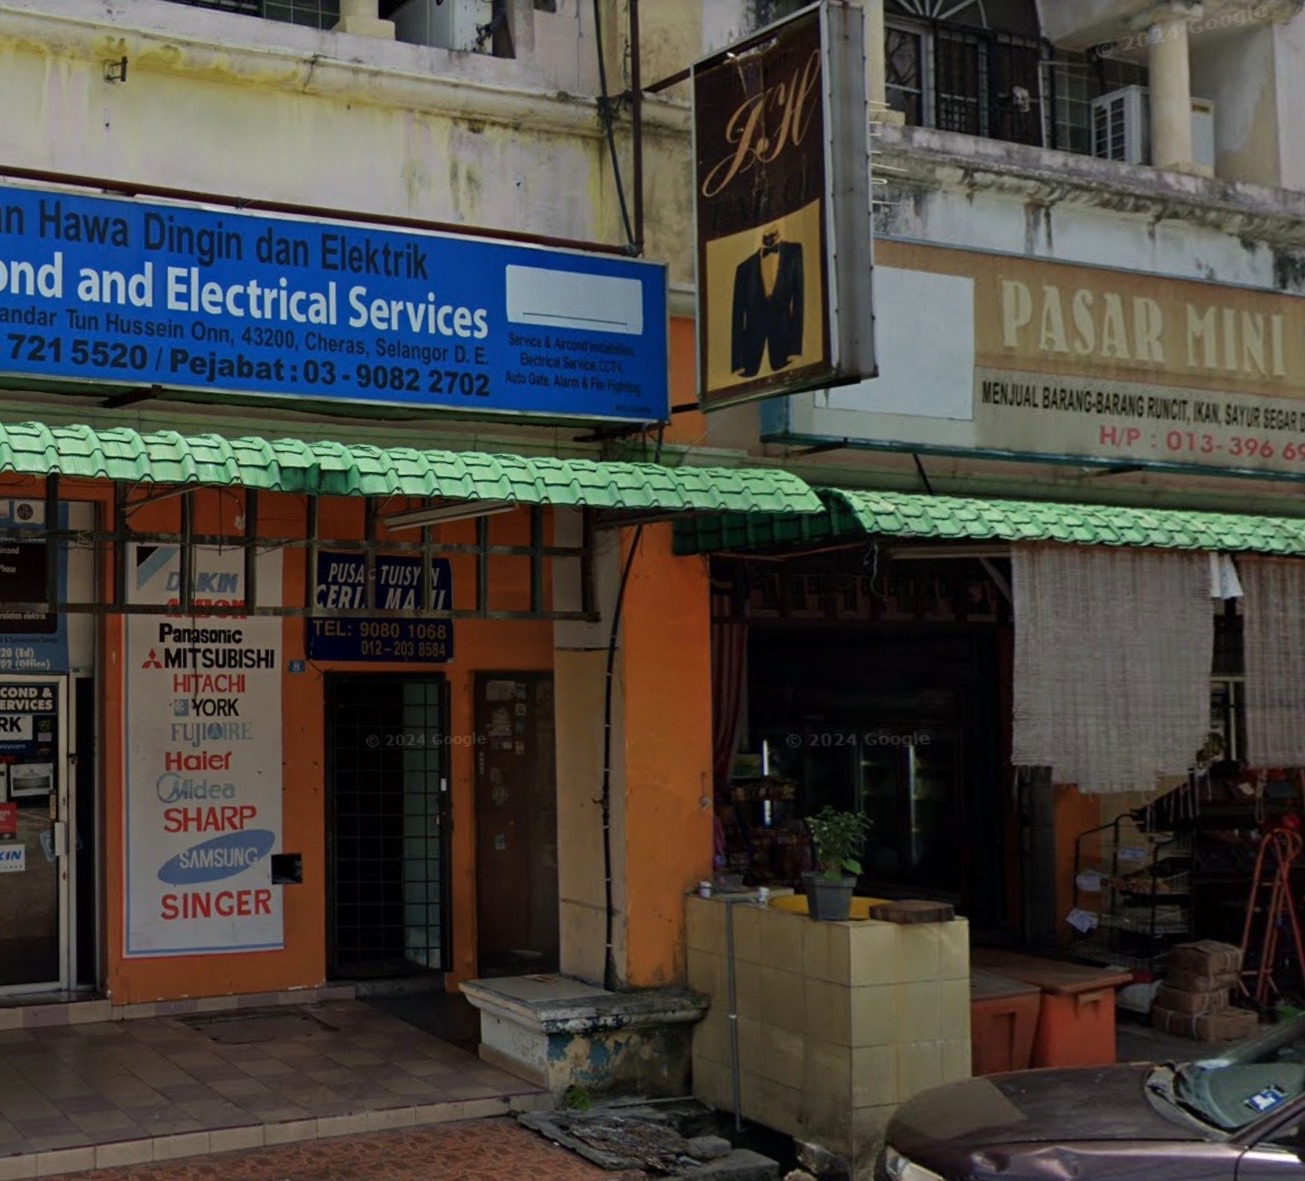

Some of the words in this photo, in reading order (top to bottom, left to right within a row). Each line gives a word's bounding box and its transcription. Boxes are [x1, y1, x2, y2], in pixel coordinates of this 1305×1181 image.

[39, 199, 129, 247] Hawa
[144, 212, 242, 267] Dingin
[256, 227, 309, 267] dan
[321, 233, 428, 280] Elektrik
[78, 262, 153, 308] and
[167, 266, 336, 325] Electrical
[349, 286, 488, 339] Services
[65, 309, 99, 331] Tun
[106, 313, 184, 339] Hussein
[191, 321, 235, 347] Onn,
[241, 326, 299, 351] 43200,
[305, 332, 369, 358] Cheras,
[376, 338, 448, 366] Selangor
[455, 345, 469, 364] D.
[475, 346, 490, 365] E.
[1001, 280, 1166, 364] PASAR
[1186, 302, 1289, 377] MINI
[508, 332, 542, 348] Service
[544, 336, 552, 348] &
[555, 337, 588, 351] Aircond
[7, 333, 61, 362] 721
[71, 340, 148, 370] 5520
[170, 347, 284, 382] Pejabat
[303, 360, 336, 385] 03
[356, 364, 420, 392] 9082
[428, 370, 491, 397] 2702
[520, 352, 561, 368] Electrical
[505, 370, 526, 384] Auto
[554, 374, 579, 388] Alarm
[582, 377, 588, 390] &
[982, 380, 1039, 409] MENJUAL
[1042, 386, 1144, 418] BARANG-BARANG
[1147, 396, 1191, 423] RUNCIT,
[1193, 401, 1222, 427] IKAN,
[1225, 404, 1261, 428] SAYUR
[1263, 408, 1298, 432] SEGAR
[1099, 425, 1142, 449] H/P
[327, 563, 365, 584] PUSA
[380, 565, 440, 586] TUISYN
[159, 622, 243, 644] Panasonic
[313, 620, 353, 637] TEL:
[359, 621, 401, 638] 9080
[408, 623, 447, 639] 1068
[15, 647, 35, 659] (Ed)
[164, 648, 275, 669] MITSUBISHI
[418, 642, 446, 657] 8584
[15, 658, 51, 670] (Office)
[42, 687, 53, 698] &
[173, 674, 246, 693] HITACHI
[192, 698, 240, 717] YORK
[165, 750, 232, 771] Haier
[156, 773, 236, 804] Midea
[163, 805, 257, 833] SHARP
[179, 847, 258, 869] SAMSUNG
[161, 889, 272, 920] SINGER
